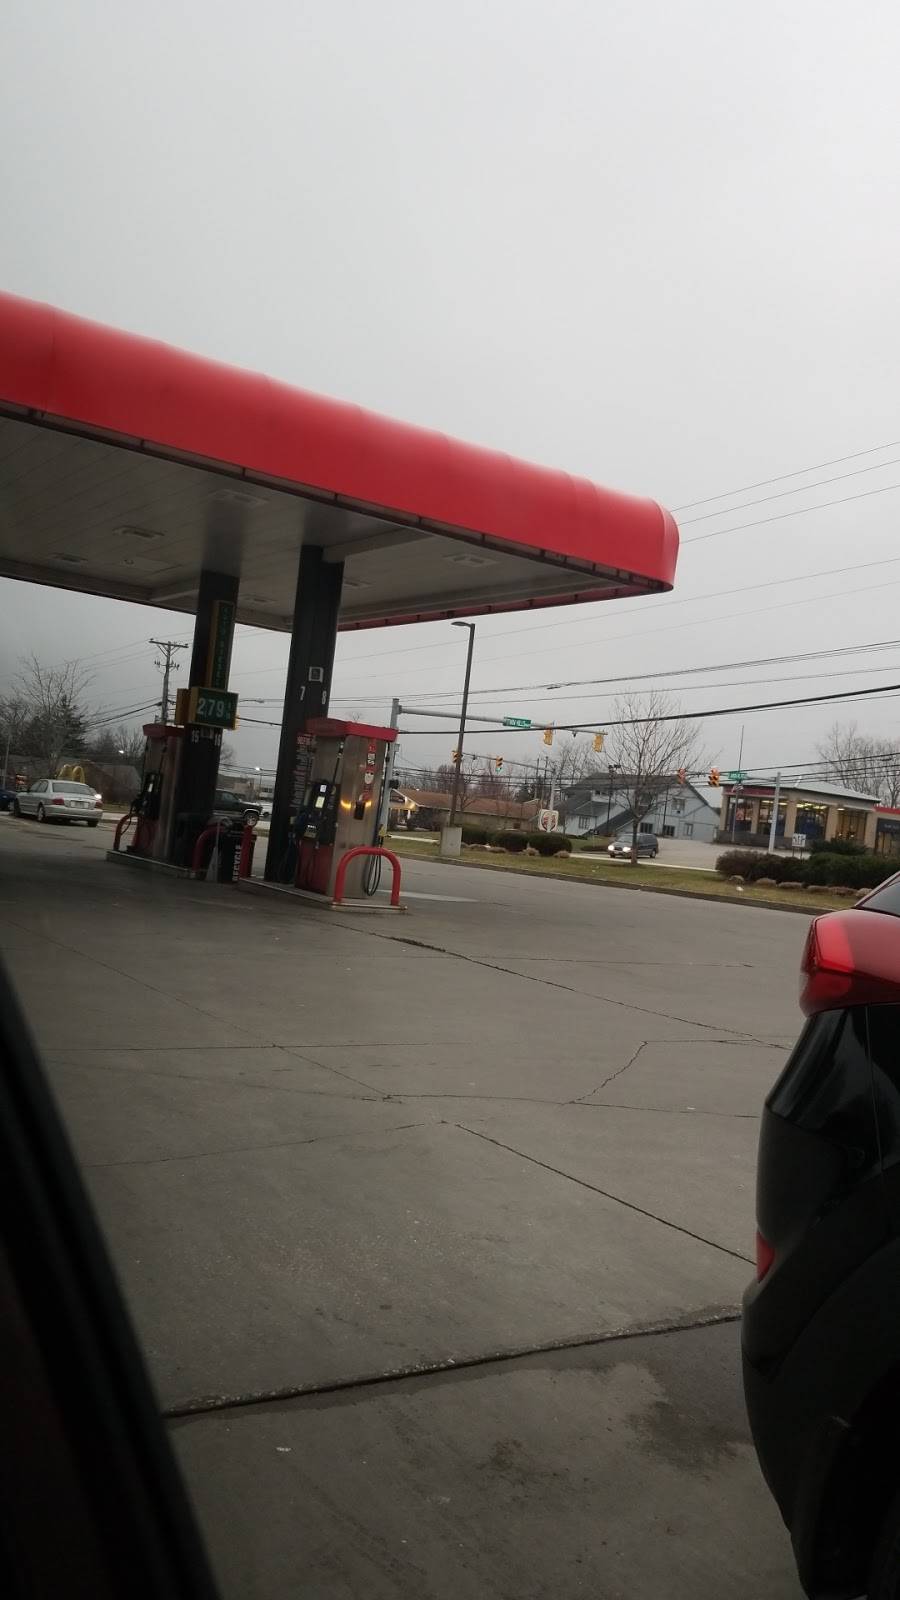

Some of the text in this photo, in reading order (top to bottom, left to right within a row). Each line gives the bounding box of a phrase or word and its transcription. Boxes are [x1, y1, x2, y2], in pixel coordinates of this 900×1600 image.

[300, 685, 306, 701] 7
[321, 690, 327, 705] 8
[232, 844, 241, 882] RECYCLE
